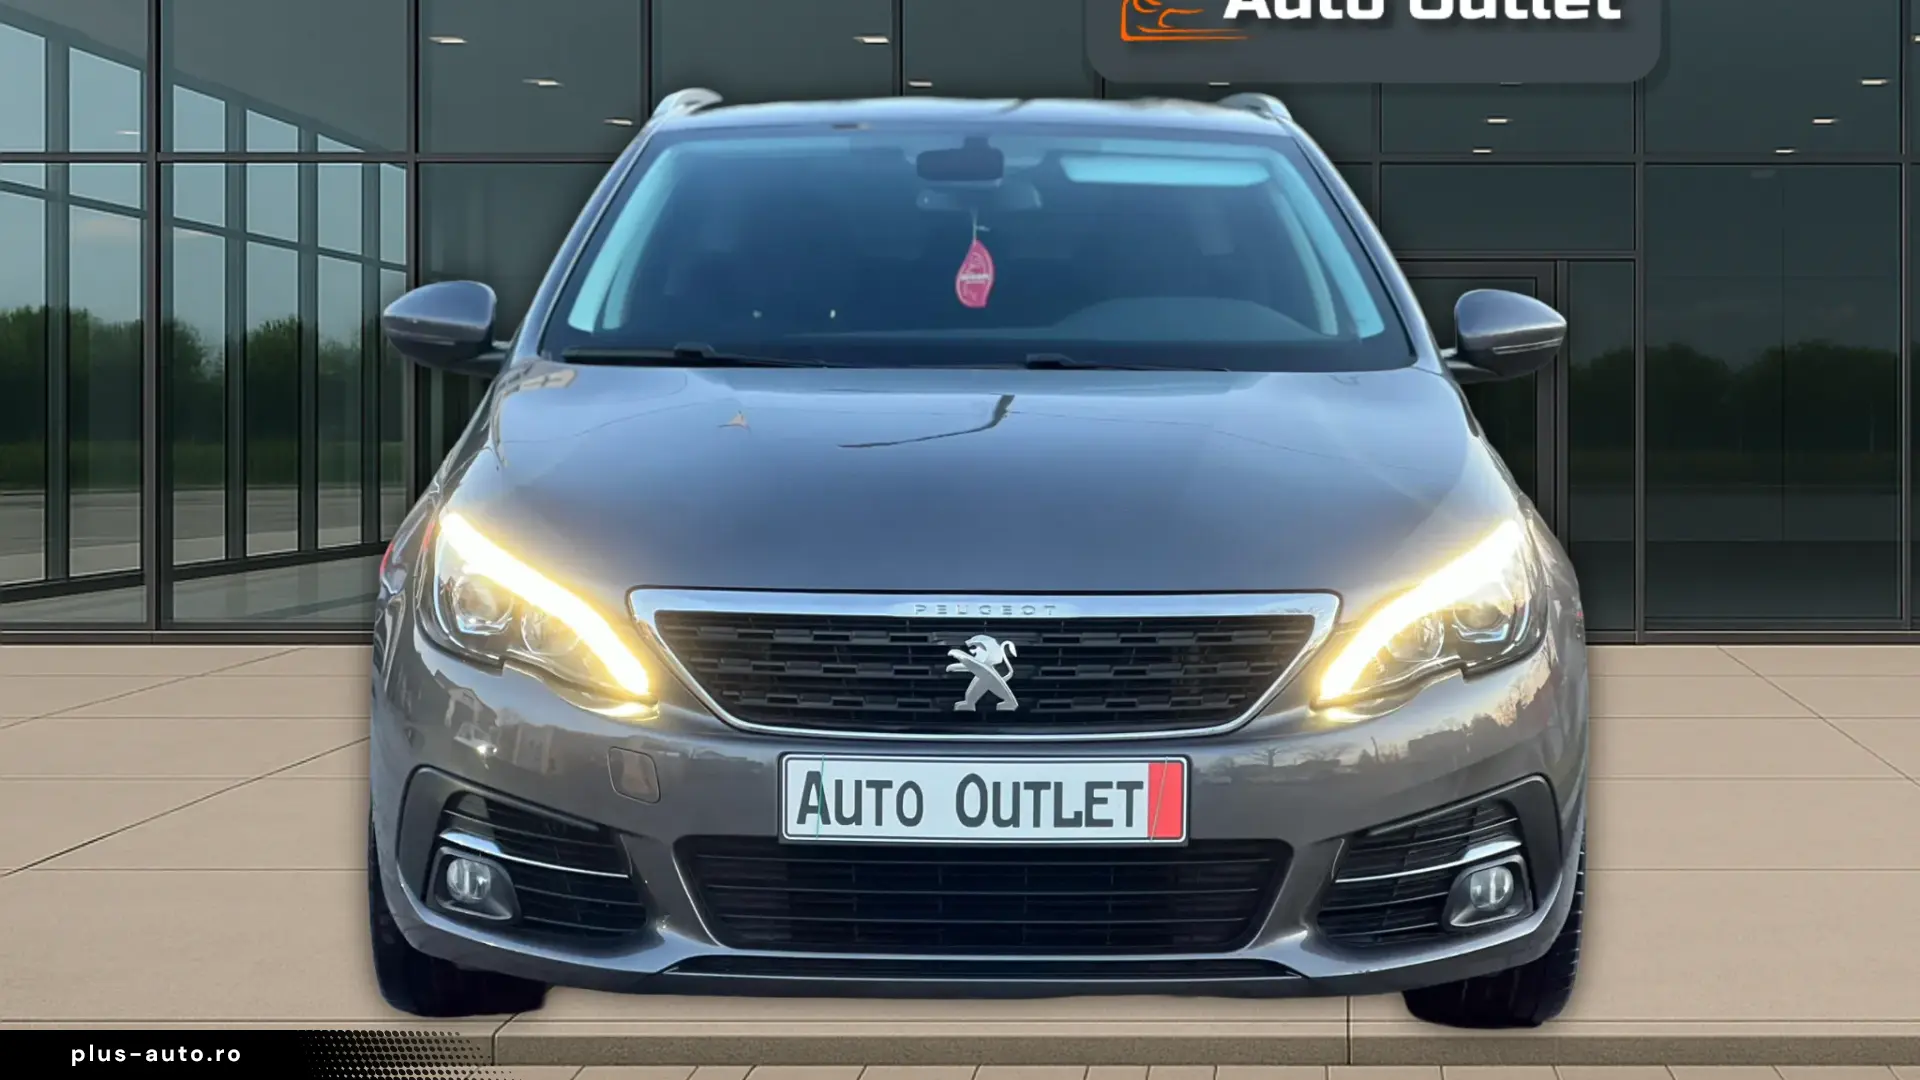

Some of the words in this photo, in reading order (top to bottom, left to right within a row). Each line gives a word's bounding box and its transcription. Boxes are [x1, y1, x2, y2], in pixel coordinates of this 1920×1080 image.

[1223, 0, 1385, 20] Auto
[1409, 0, 1621, 20] Outlet
[914, 604, 1056, 616] PEUGEOT
[796, 770, 924, 827] AUTO
[955, 773, 1144, 829] OUTLET
